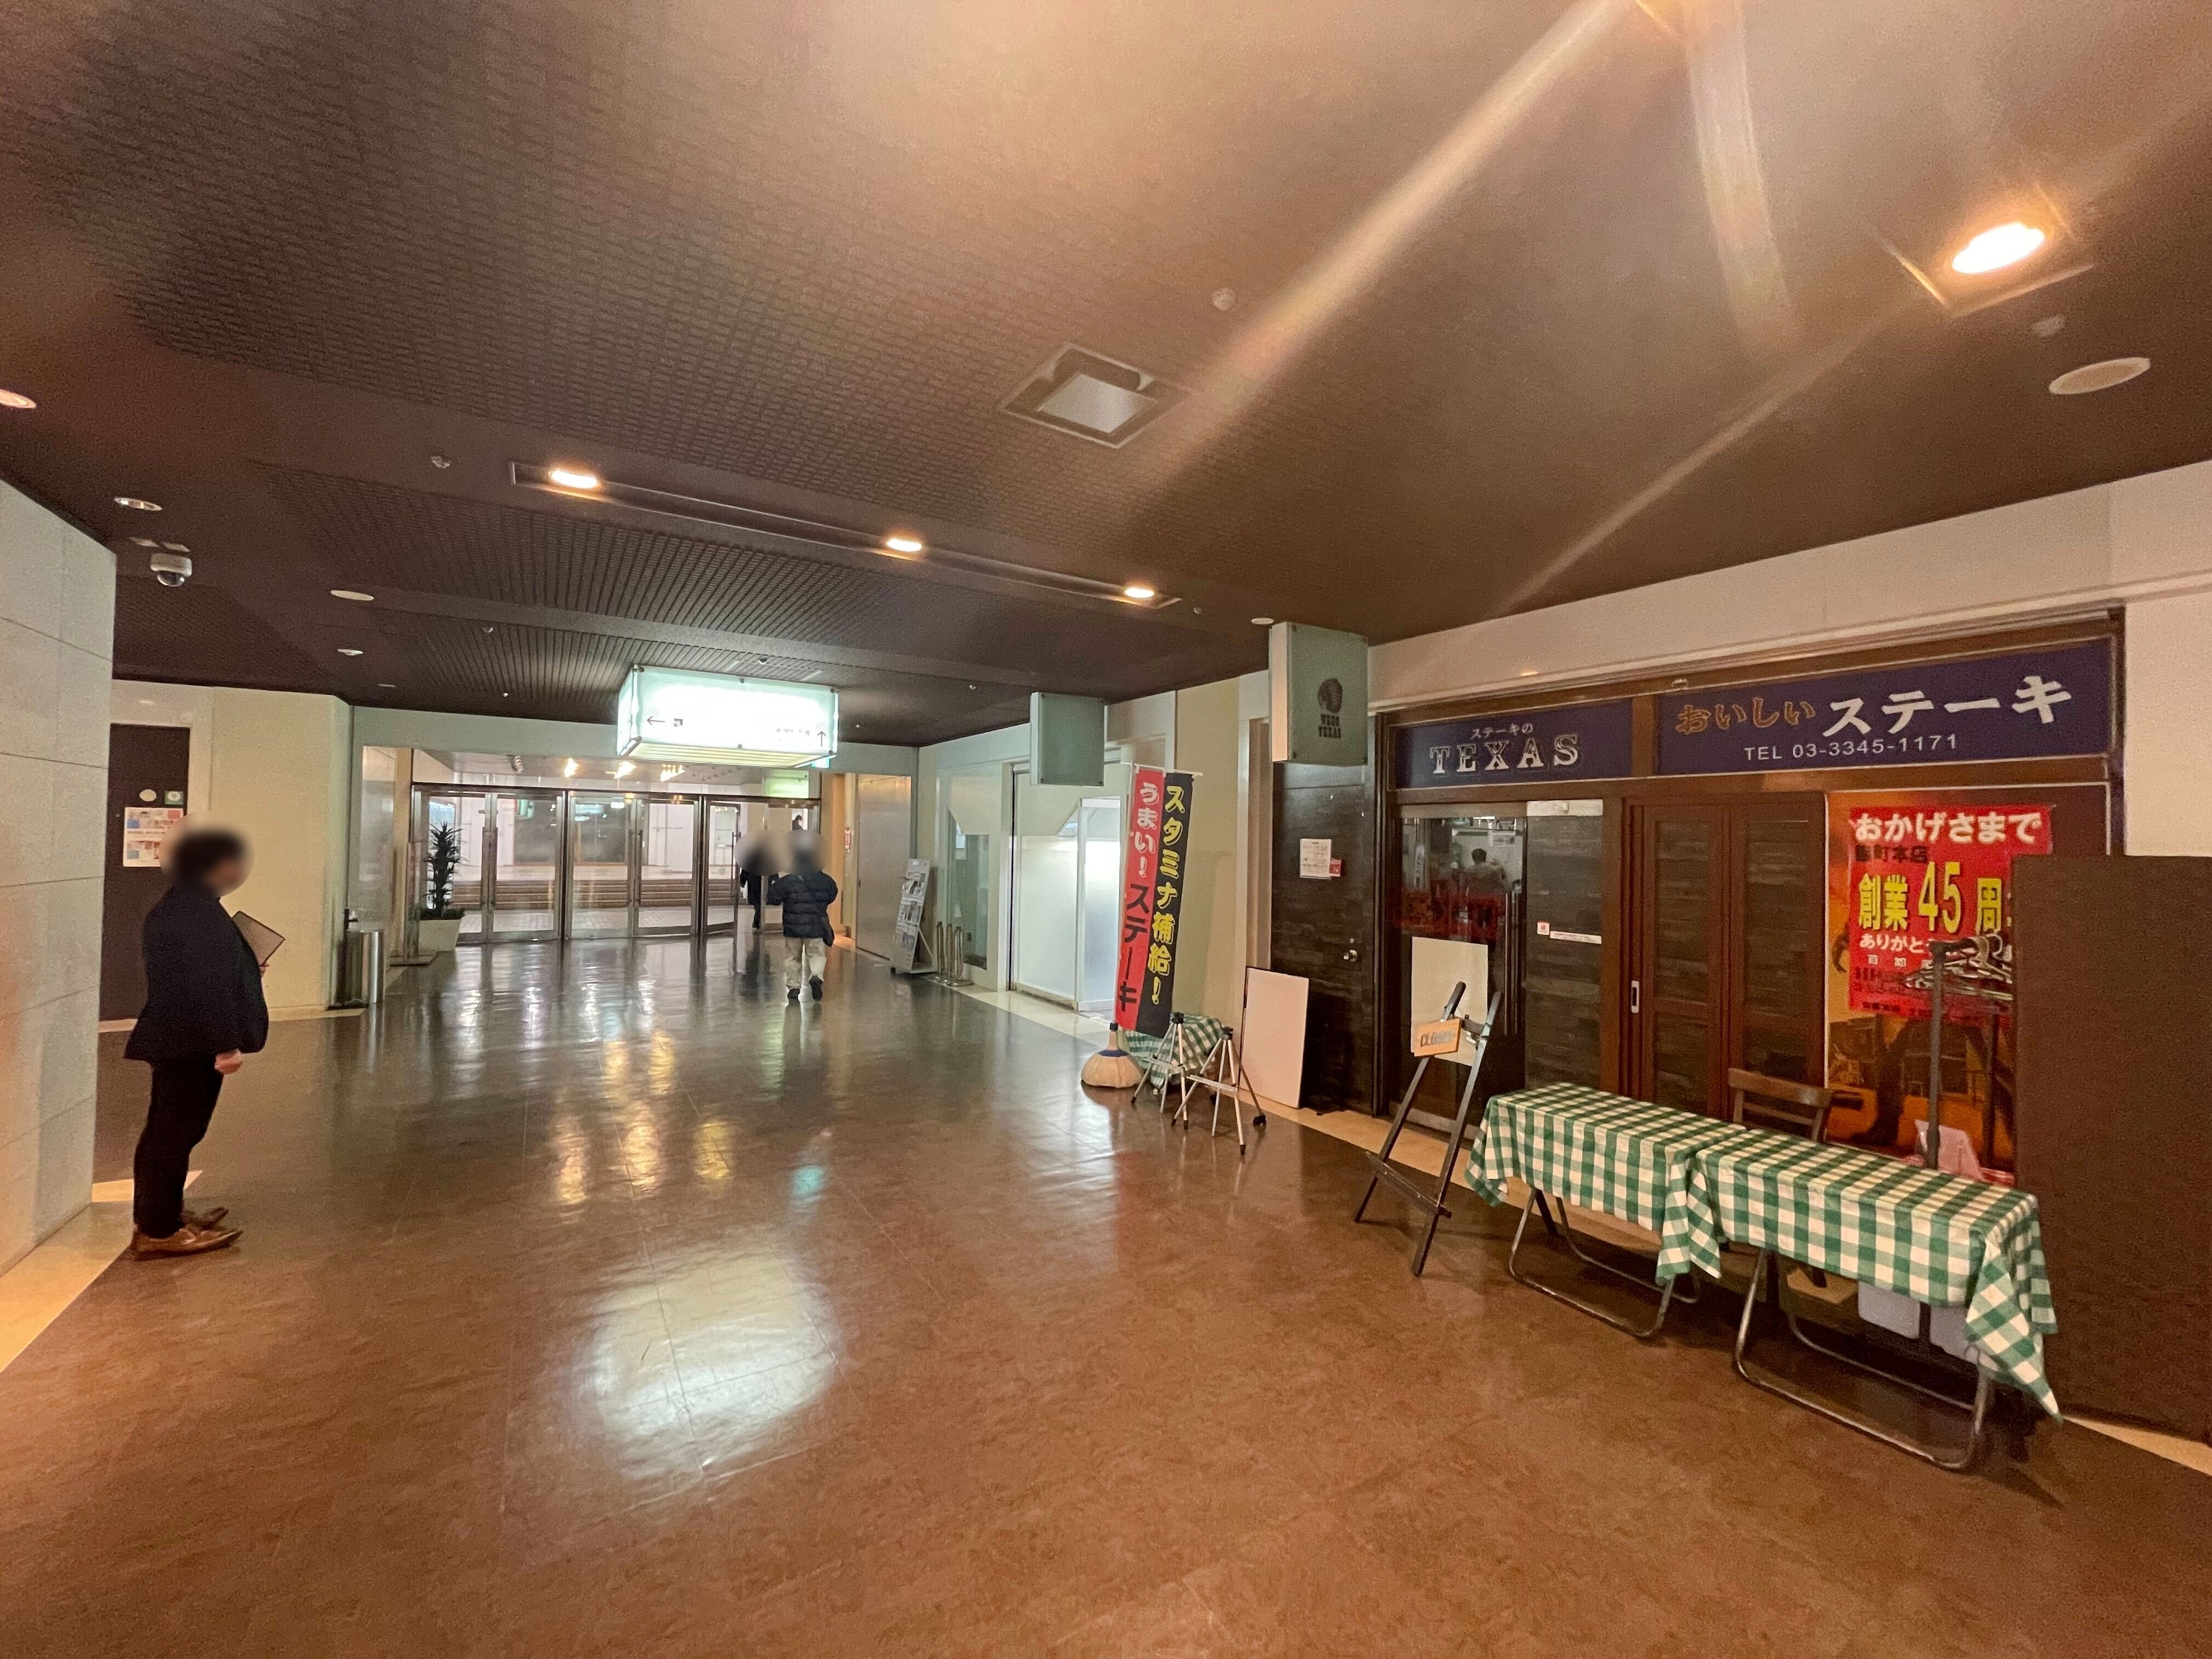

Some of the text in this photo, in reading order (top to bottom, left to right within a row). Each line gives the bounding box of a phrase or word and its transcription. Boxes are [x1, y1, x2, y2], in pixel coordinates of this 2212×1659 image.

[1318, 726, 1341, 738] TEXAS
[1470, 723, 1533, 740] ステーキの
[1429, 733, 1579, 774] TEXAS
[1743, 733, 1956, 761] TEL 03-3345-1171
[1855, 812, 2042, 844] おかげさまで
